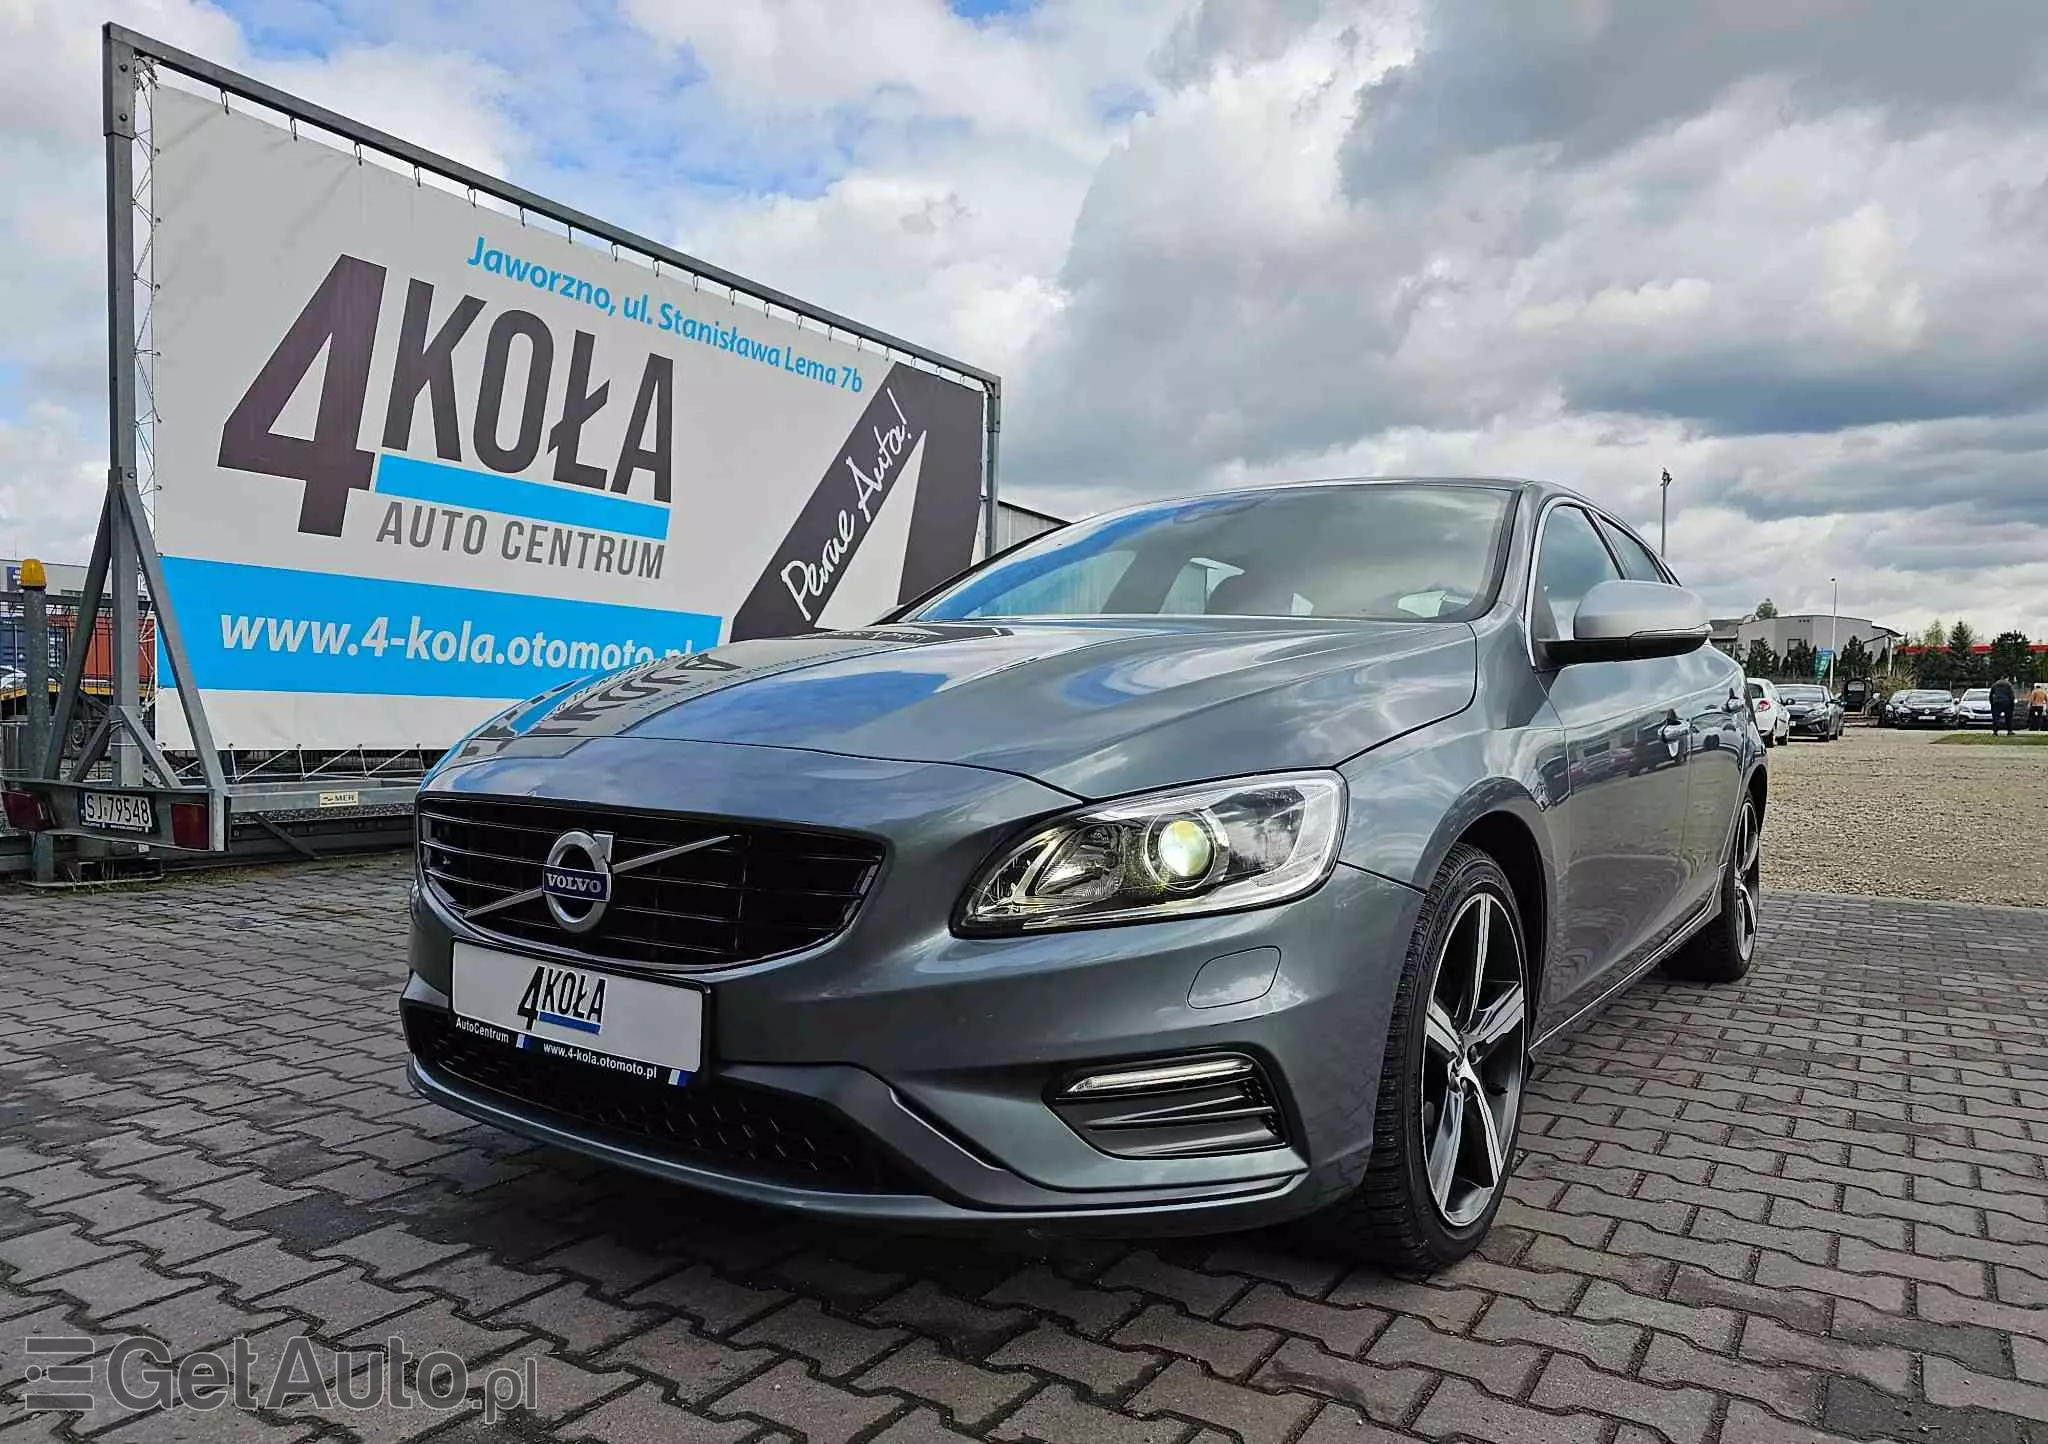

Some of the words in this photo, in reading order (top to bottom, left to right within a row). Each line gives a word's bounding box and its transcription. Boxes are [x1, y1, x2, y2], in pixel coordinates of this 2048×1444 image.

[466, 236, 616, 318] Jaworzno,
[623, 292, 652, 325] ul.
[659, 303, 780, 367] Stanisława
[785, 345, 836, 385] Lema
[841, 365, 863, 392] 7b
[846, 388, 912, 523] Auta!
[376, 501, 487, 556] AUTO
[501, 520, 666, 579] CENTRUM
[220, 614, 693, 670] www.4-kola.otomoto
[107, 797, 150, 825] 79548
[545, 873, 602, 893] VOLVO
[455, 1016, 510, 1044] AutoCentrum
[543, 1042, 657, 1079] www.4-kola.otomoto.pl
